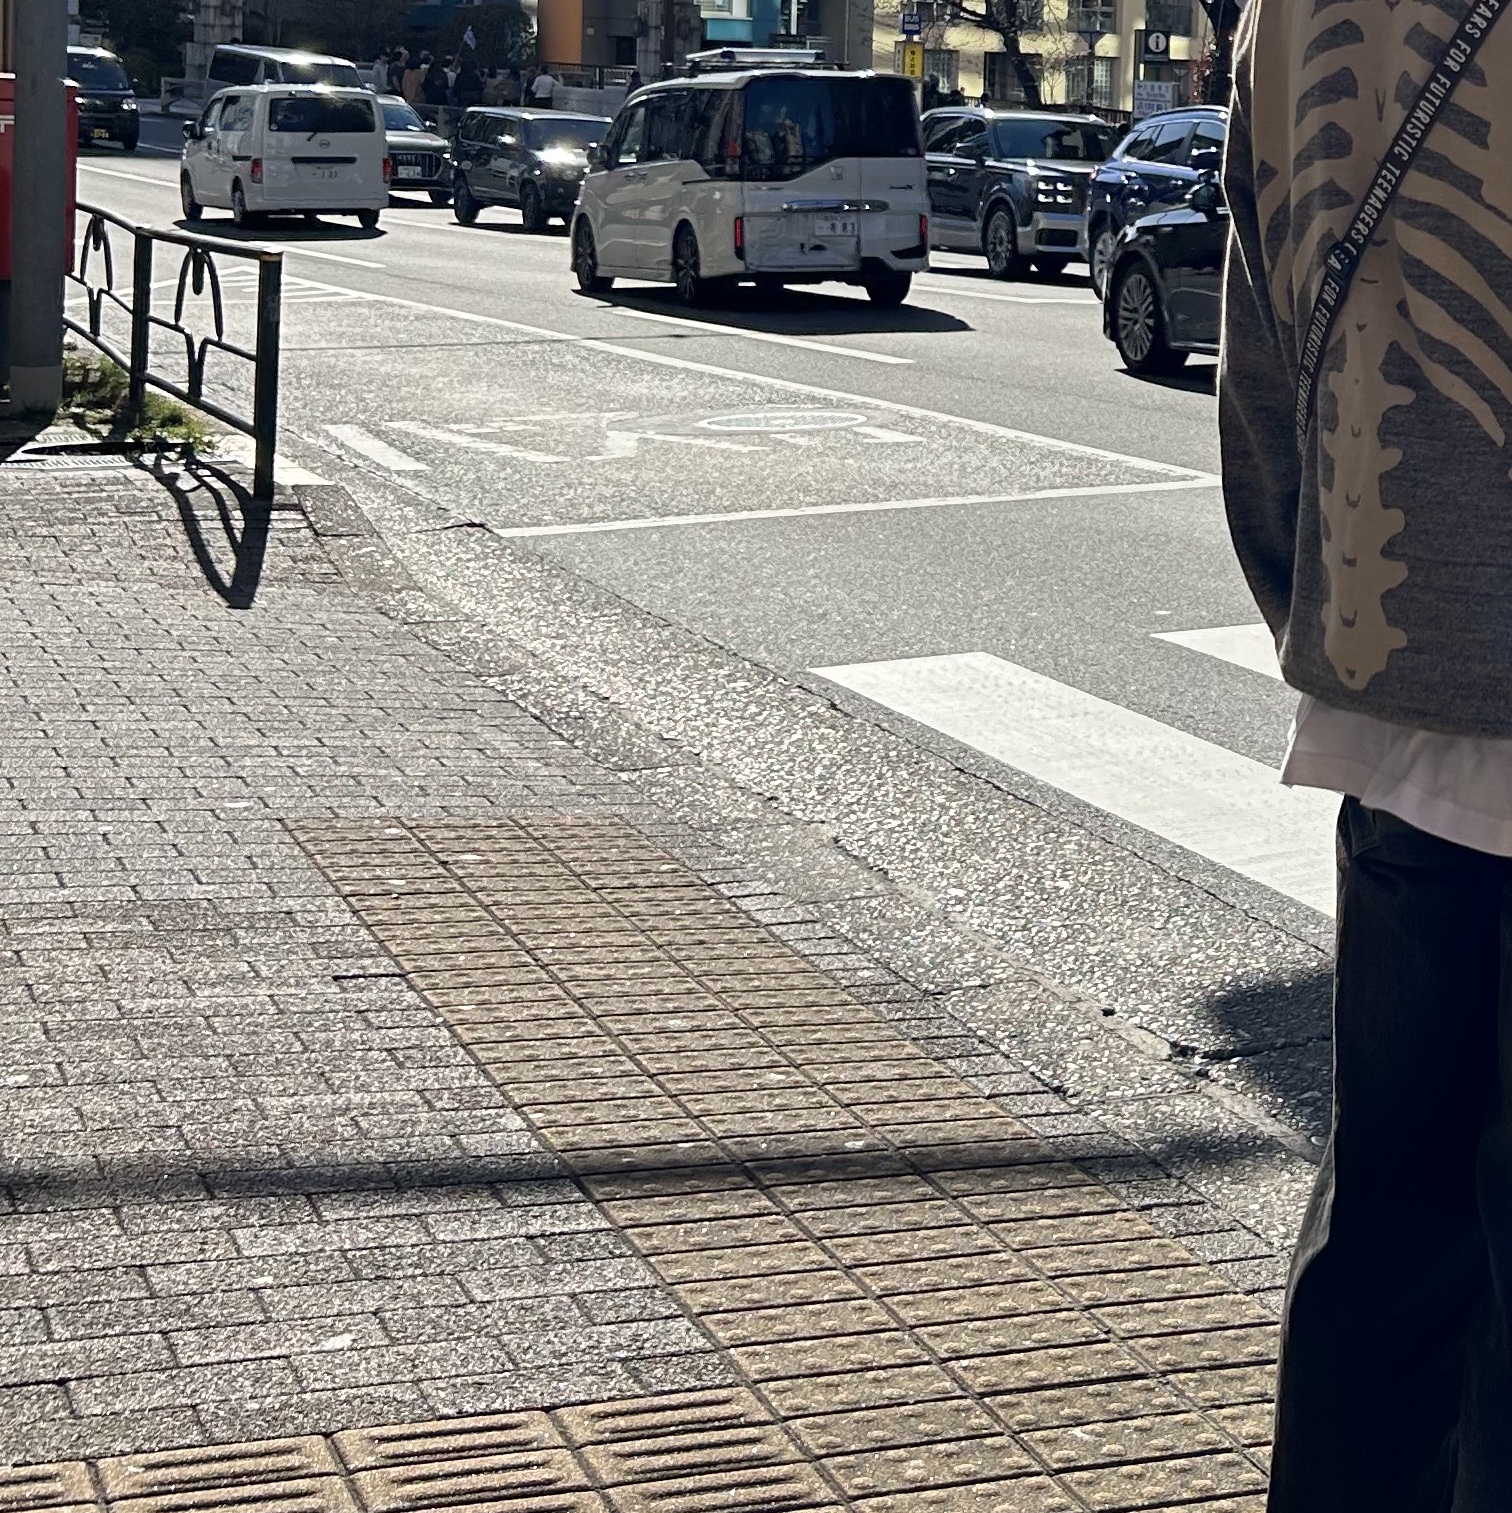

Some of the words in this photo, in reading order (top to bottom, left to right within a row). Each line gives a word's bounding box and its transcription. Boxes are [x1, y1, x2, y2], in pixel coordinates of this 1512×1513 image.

[1444, 39, 1471, 72] FOR
[1394, 73, 1451, 161] FUTURISTIC
[1351, 162, 1401, 244] TEENAGERS
[1322, 277, 1340, 306] FOR
[1303, 303, 1331, 373] FUTURISTIC
